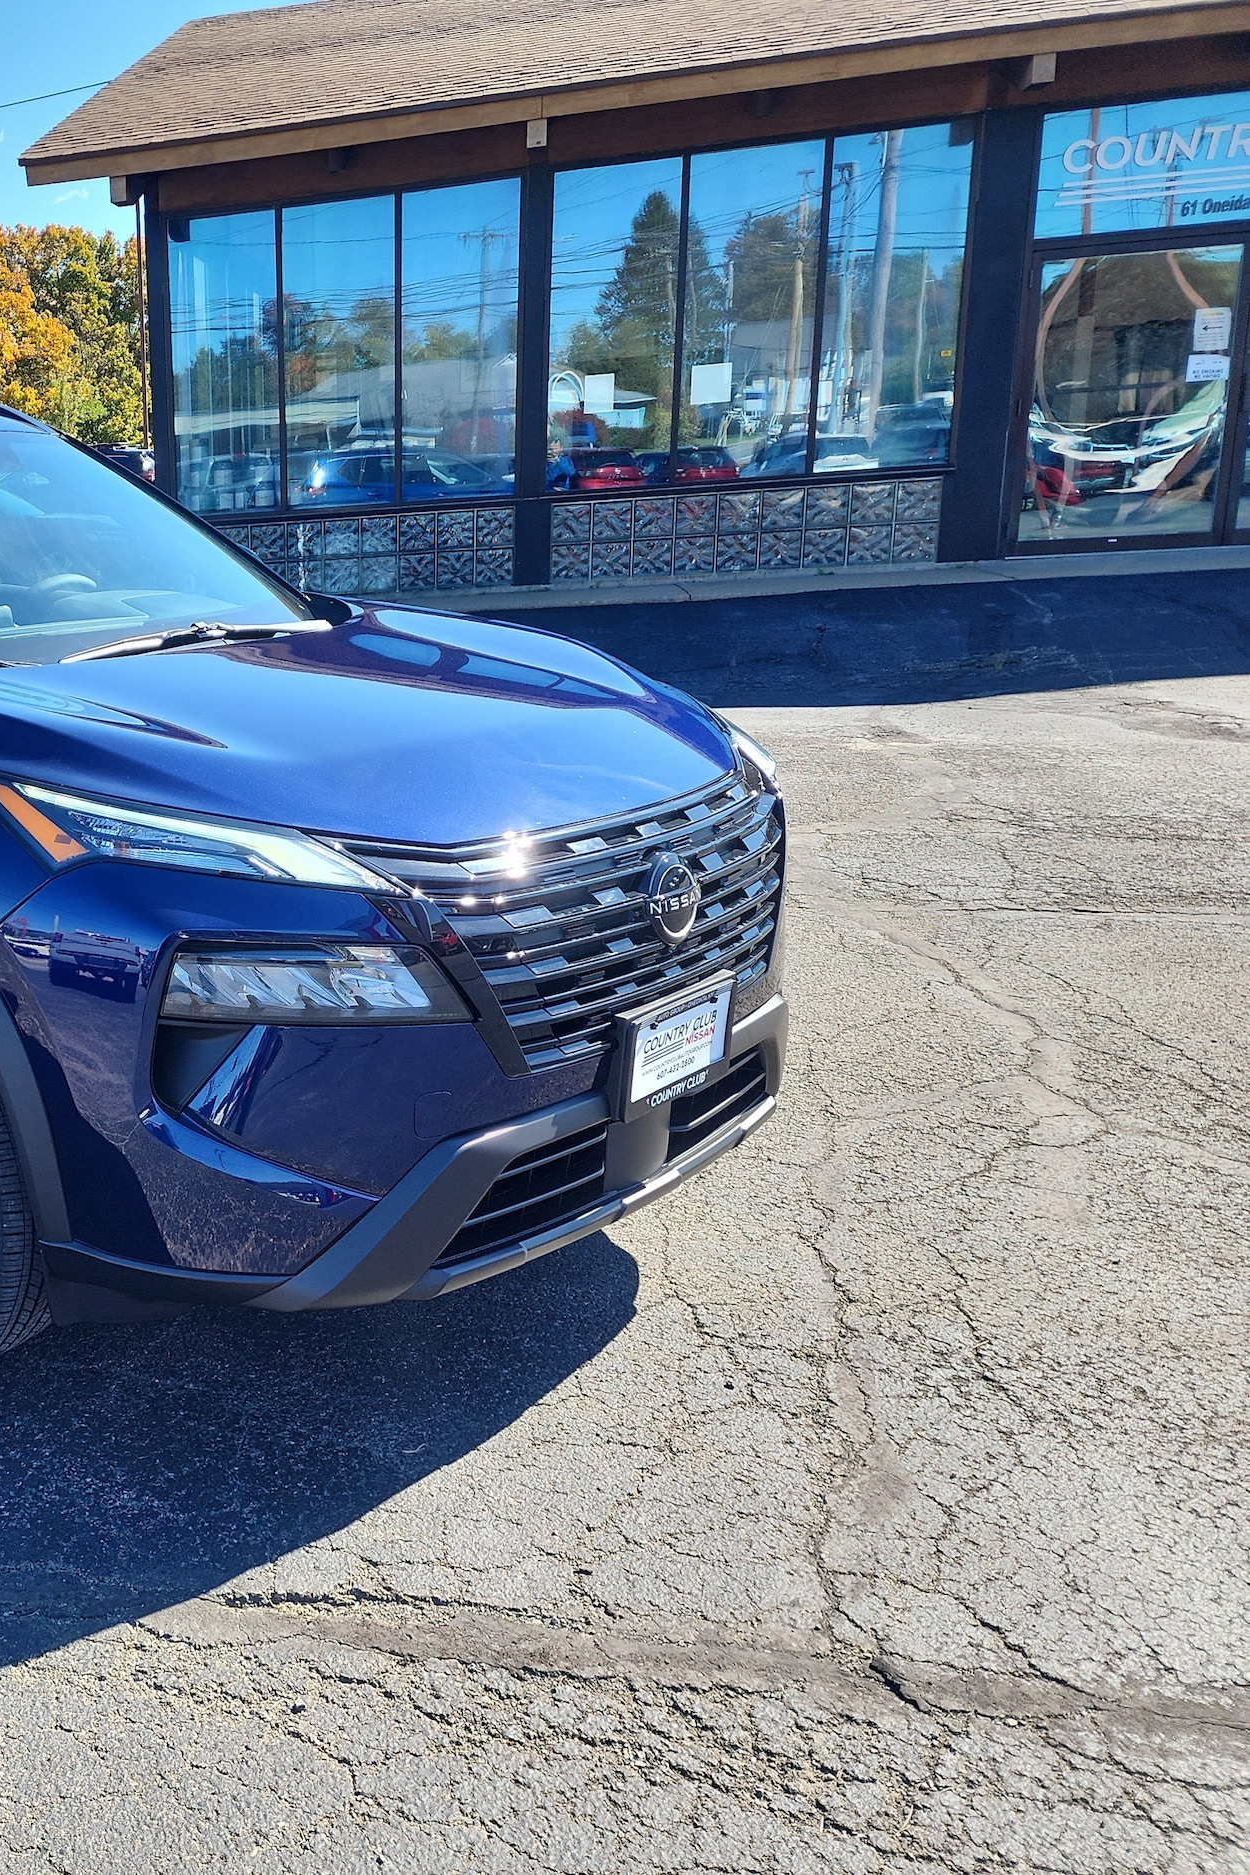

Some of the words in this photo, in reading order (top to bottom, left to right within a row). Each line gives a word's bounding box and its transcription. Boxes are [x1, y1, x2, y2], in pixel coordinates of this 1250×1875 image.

[1063, 123, 1250, 174] COUNTR
[1181, 200, 1198, 217] 61
[1202, 194, 1250, 215] Oneida
[644, 1019, 691, 1054] COUNTRY
[693, 1010, 718, 1029] CLUB
[685, 1025, 716, 1047] NISSAN
[650, 1079, 688, 1107] COUNTRY
[687, 1072, 706, 1089] CLUB
